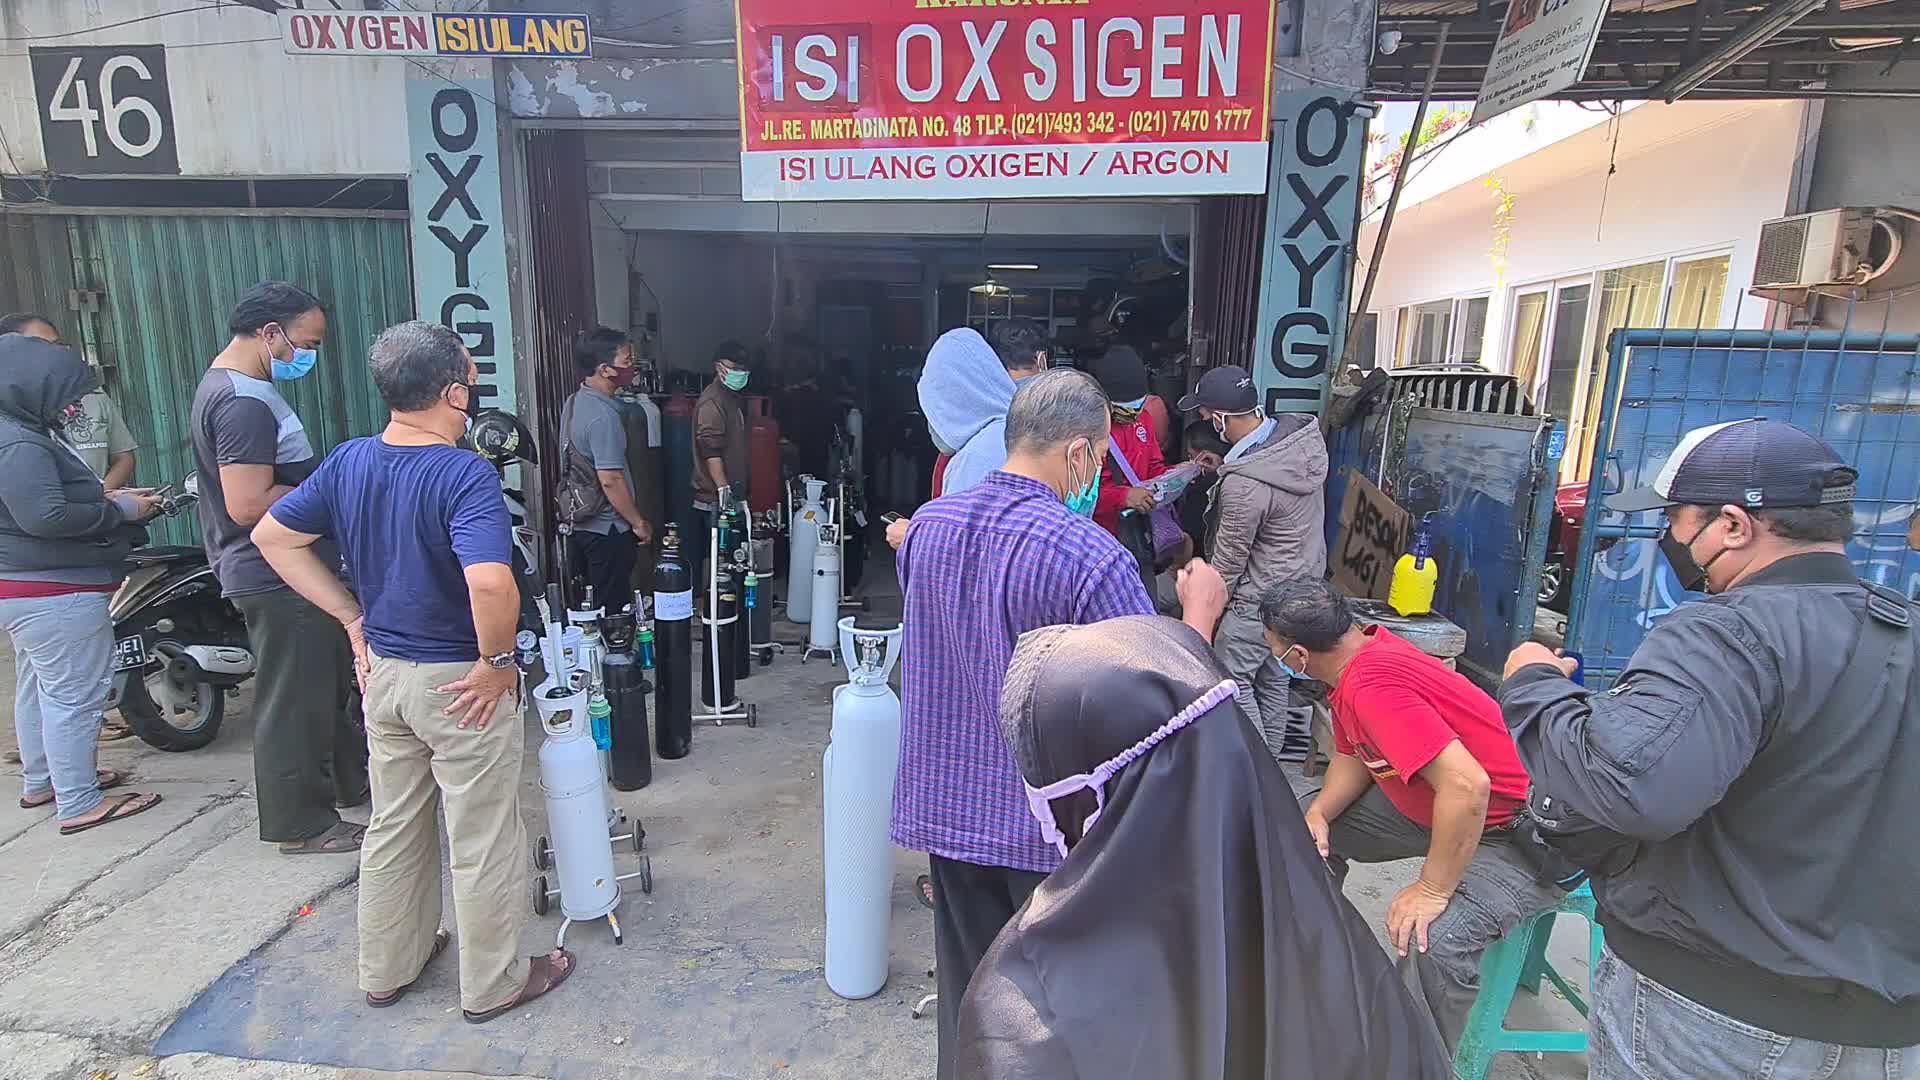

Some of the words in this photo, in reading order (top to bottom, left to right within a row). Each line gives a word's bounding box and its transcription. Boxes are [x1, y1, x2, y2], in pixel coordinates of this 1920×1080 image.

[290, 14, 429, 50] OXYGEN
[771, 33, 859, 103] ISI
[49, 55, 163, 157] 46
[810, 116, 918, 140] MARTADINATA
[922, 115, 949, 137] NO.
[953, 114, 971, 137] 48
[975, 114, 1007, 136] TLP.
[1087, 111, 1115, 133] 342
[1128, 109, 1167, 137] (021)
[1171, 110, 1209, 132] 7470
[1214, 108, 1253, 131] 1777
[779, 156, 814, 181] ISI
[824, 155, 936, 181] ULANG
[946, 151, 1069, 179] OXIGEN
[1078, 151, 1098, 176] /
[1107, 149, 1229, 176] ARGON
[1343, 522, 1381, 598] LAGI
